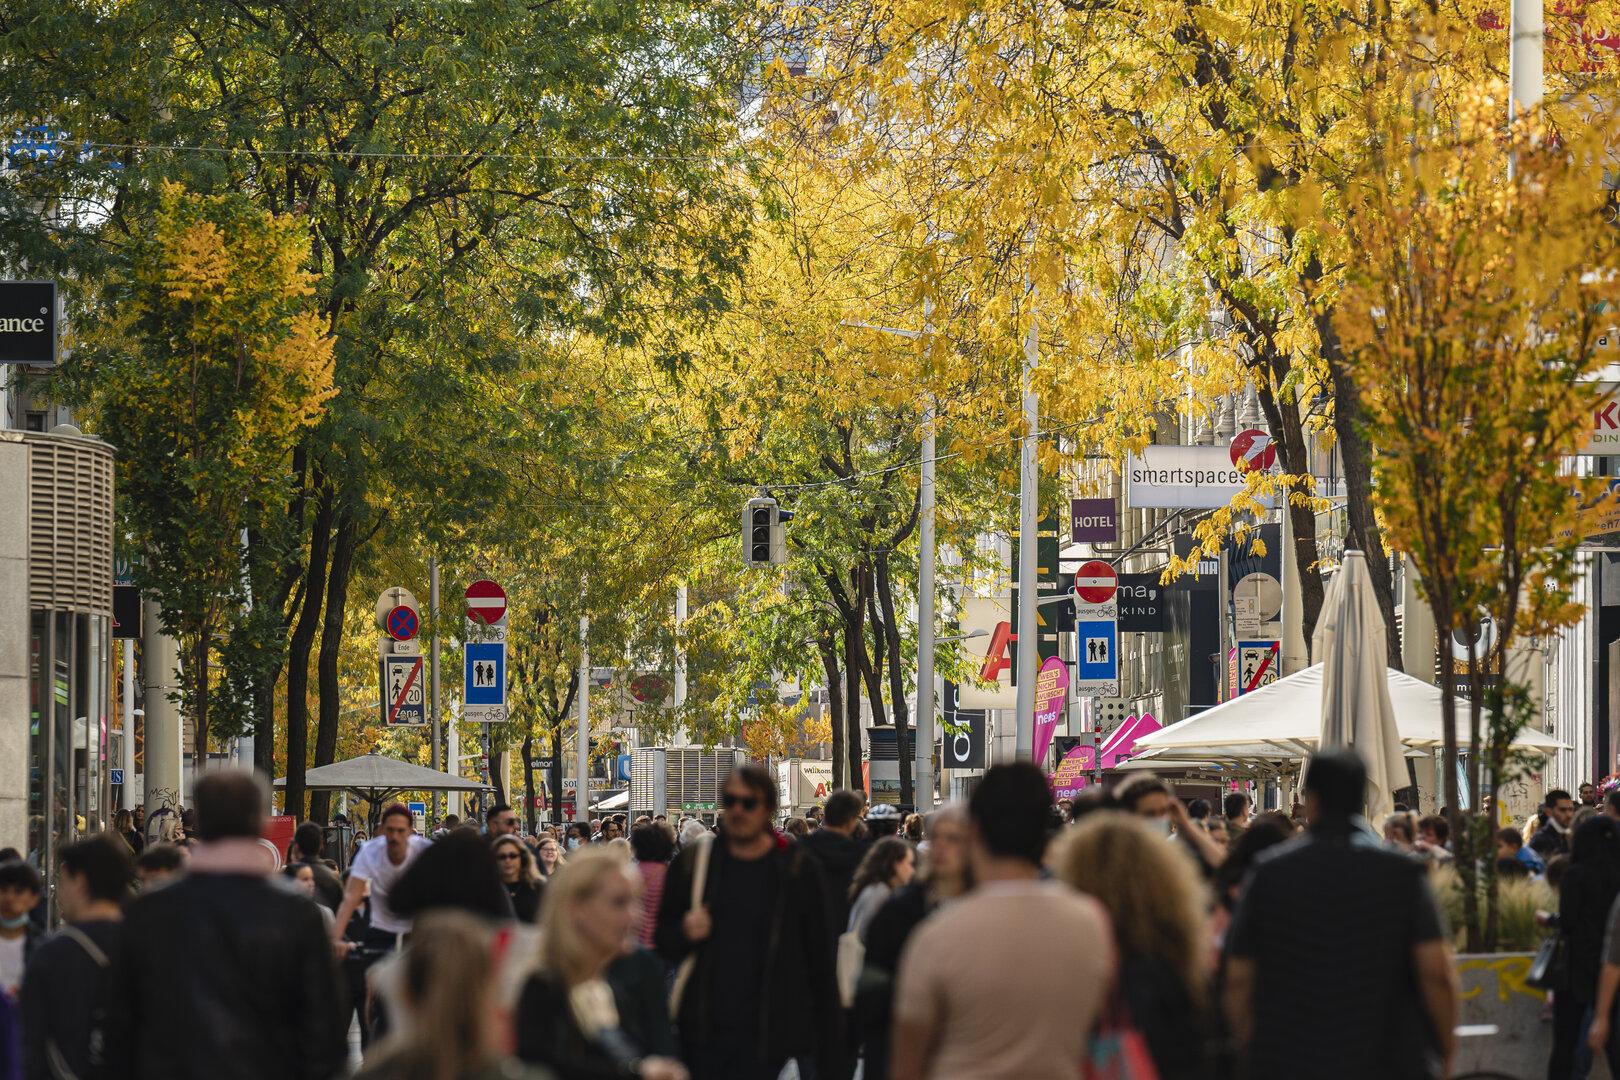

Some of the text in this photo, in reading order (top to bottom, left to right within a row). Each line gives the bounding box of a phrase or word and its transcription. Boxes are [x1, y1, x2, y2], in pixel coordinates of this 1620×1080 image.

[1075, 517, 1114, 528] HOTEL
[1121, 607, 1157, 615] KIND
[398, 644, 410, 652] Ende
[1263, 673, 1276, 685] 20
[1037, 681, 1056, 691] NICHT
[408, 689, 420, 702] 20
[1038, 712, 1056, 725] neos
[804, 766, 832, 775] Willkom
[1056, 788, 1083, 798] neos
